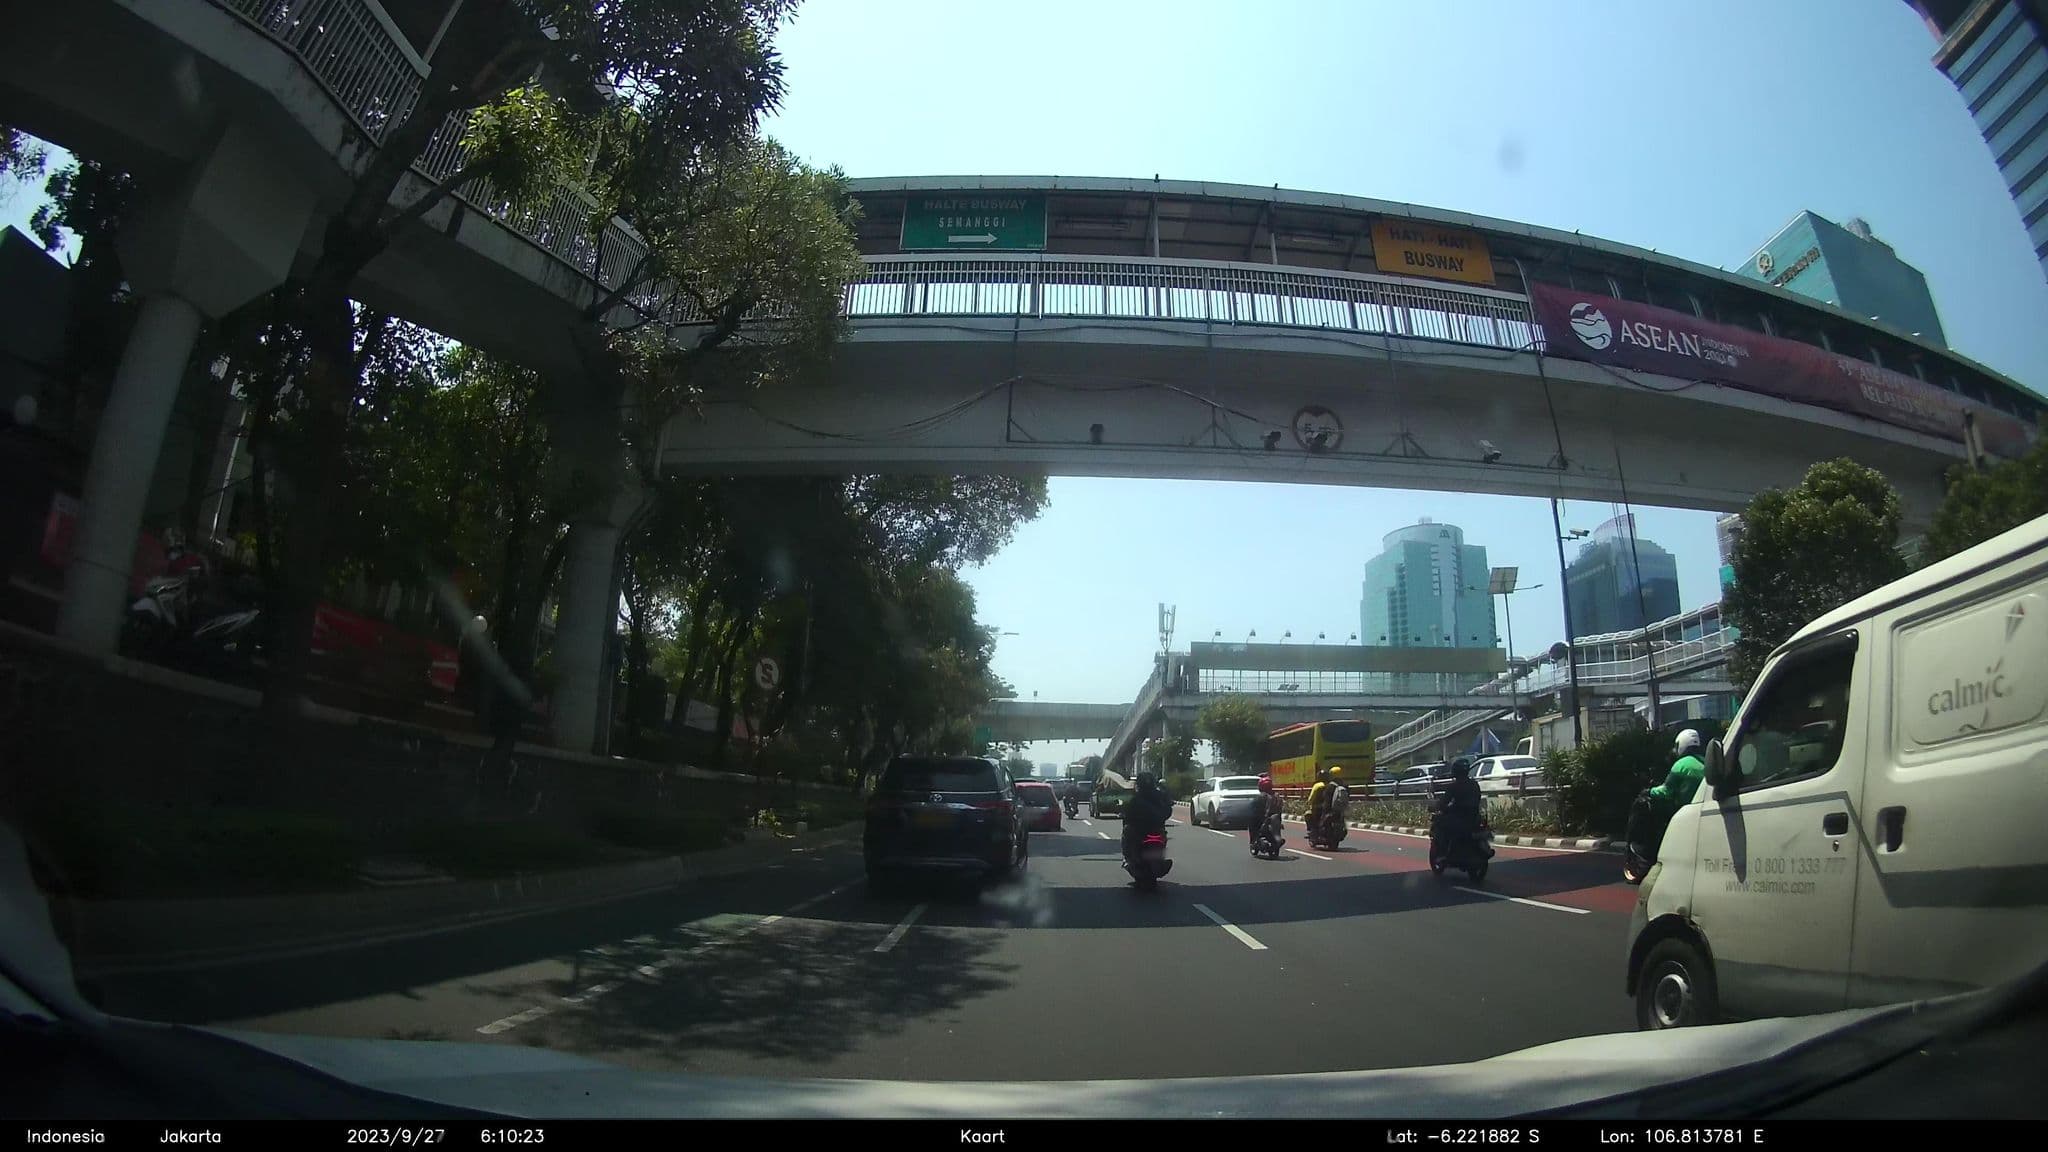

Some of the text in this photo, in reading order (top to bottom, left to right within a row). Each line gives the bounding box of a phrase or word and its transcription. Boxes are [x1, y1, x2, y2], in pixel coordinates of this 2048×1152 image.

[923, 199, 1027, 210] HALTE BUSWAY
[938, 216, 1007, 228] SEMANGGI
[1403, 250, 1465, 272] BUSWAY
[1620, 318, 1701, 358] ASEAN
[1927, 665, 2005, 716] calmic
[1703, 857, 1719, 873] Toll
[1754, 857, 1761, 874] 0
[1725, 881, 1816, 895] www.calmic.com
